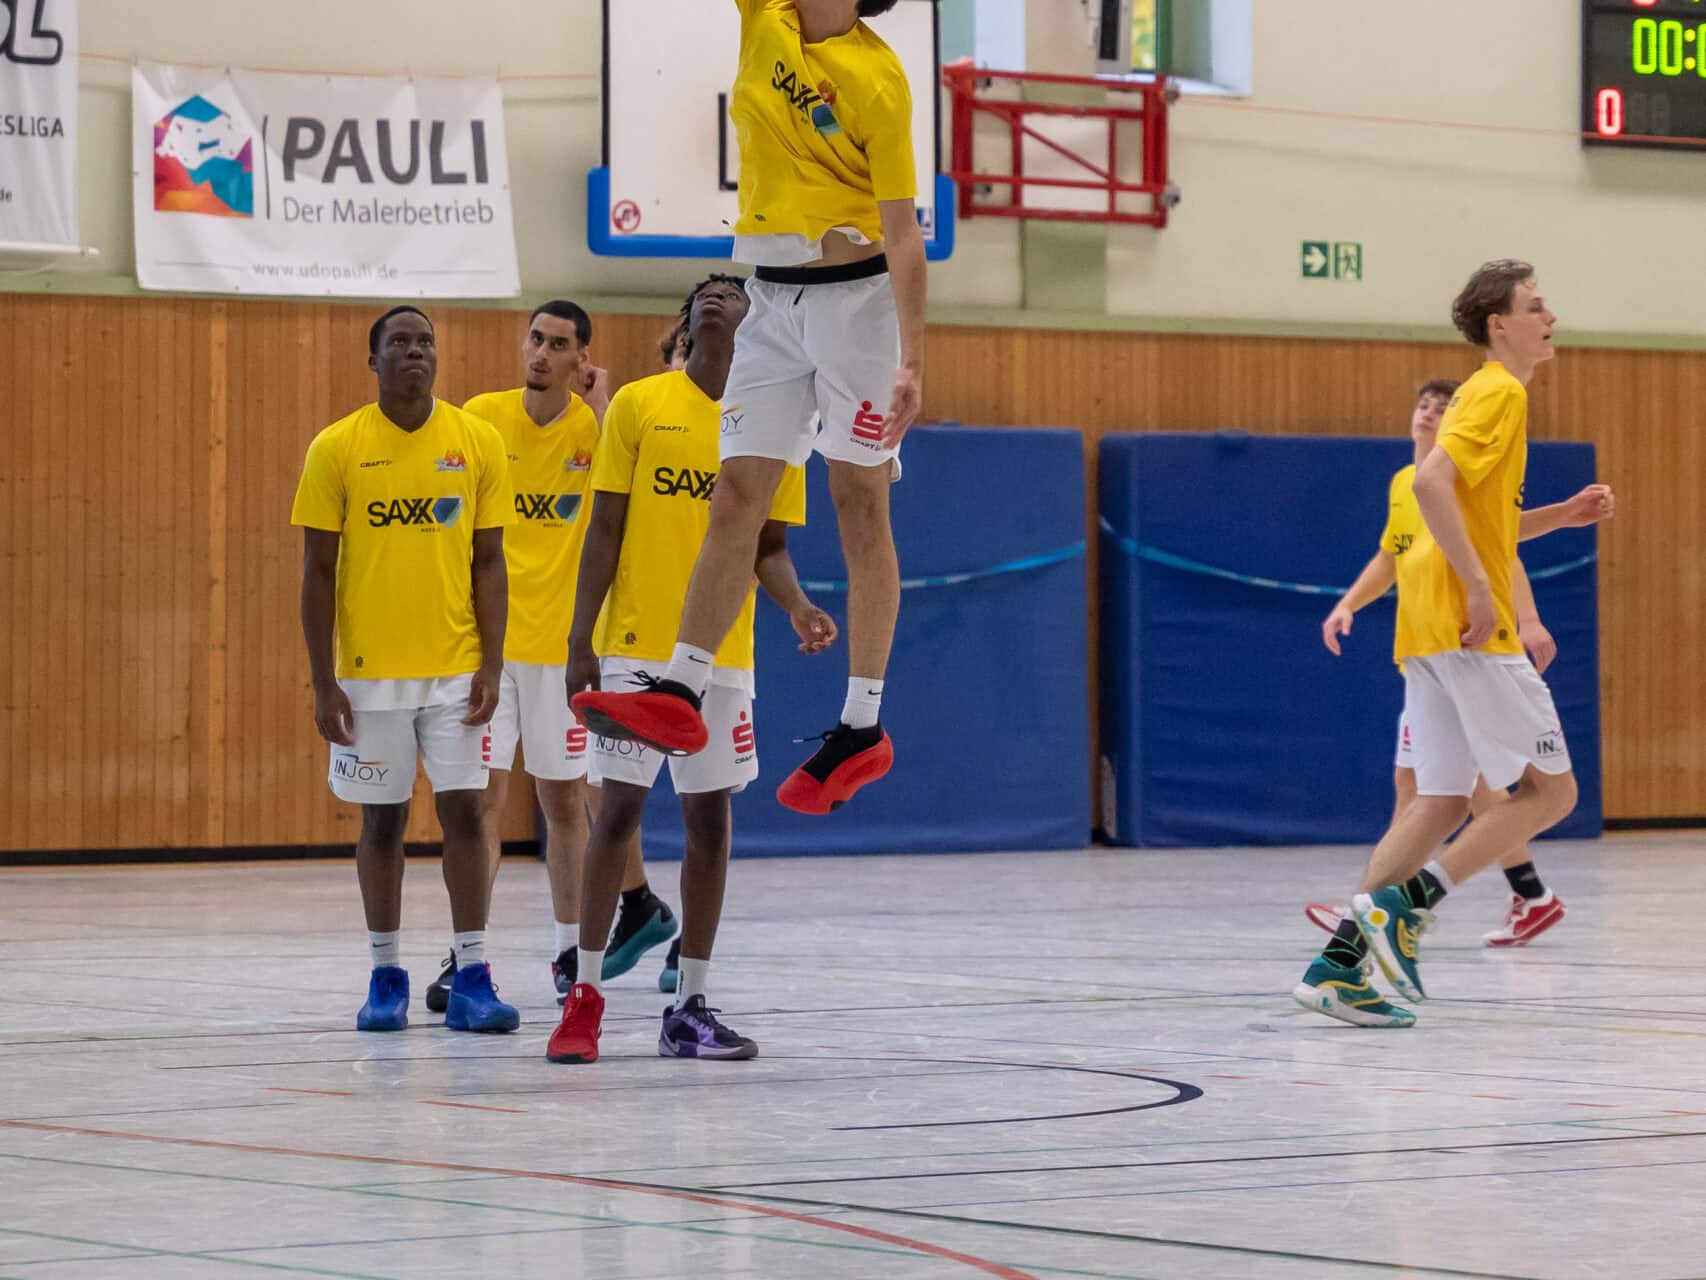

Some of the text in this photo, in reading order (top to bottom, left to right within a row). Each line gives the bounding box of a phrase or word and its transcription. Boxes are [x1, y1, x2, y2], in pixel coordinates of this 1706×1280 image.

[0, 114, 64, 138] SLIGA
[1597, 88, 1623, 136] 0
[282, 116, 489, 186] PAULI
[283, 196, 495, 225] Der Malerbetrieb
[334, 758, 389, 782] INJOY
